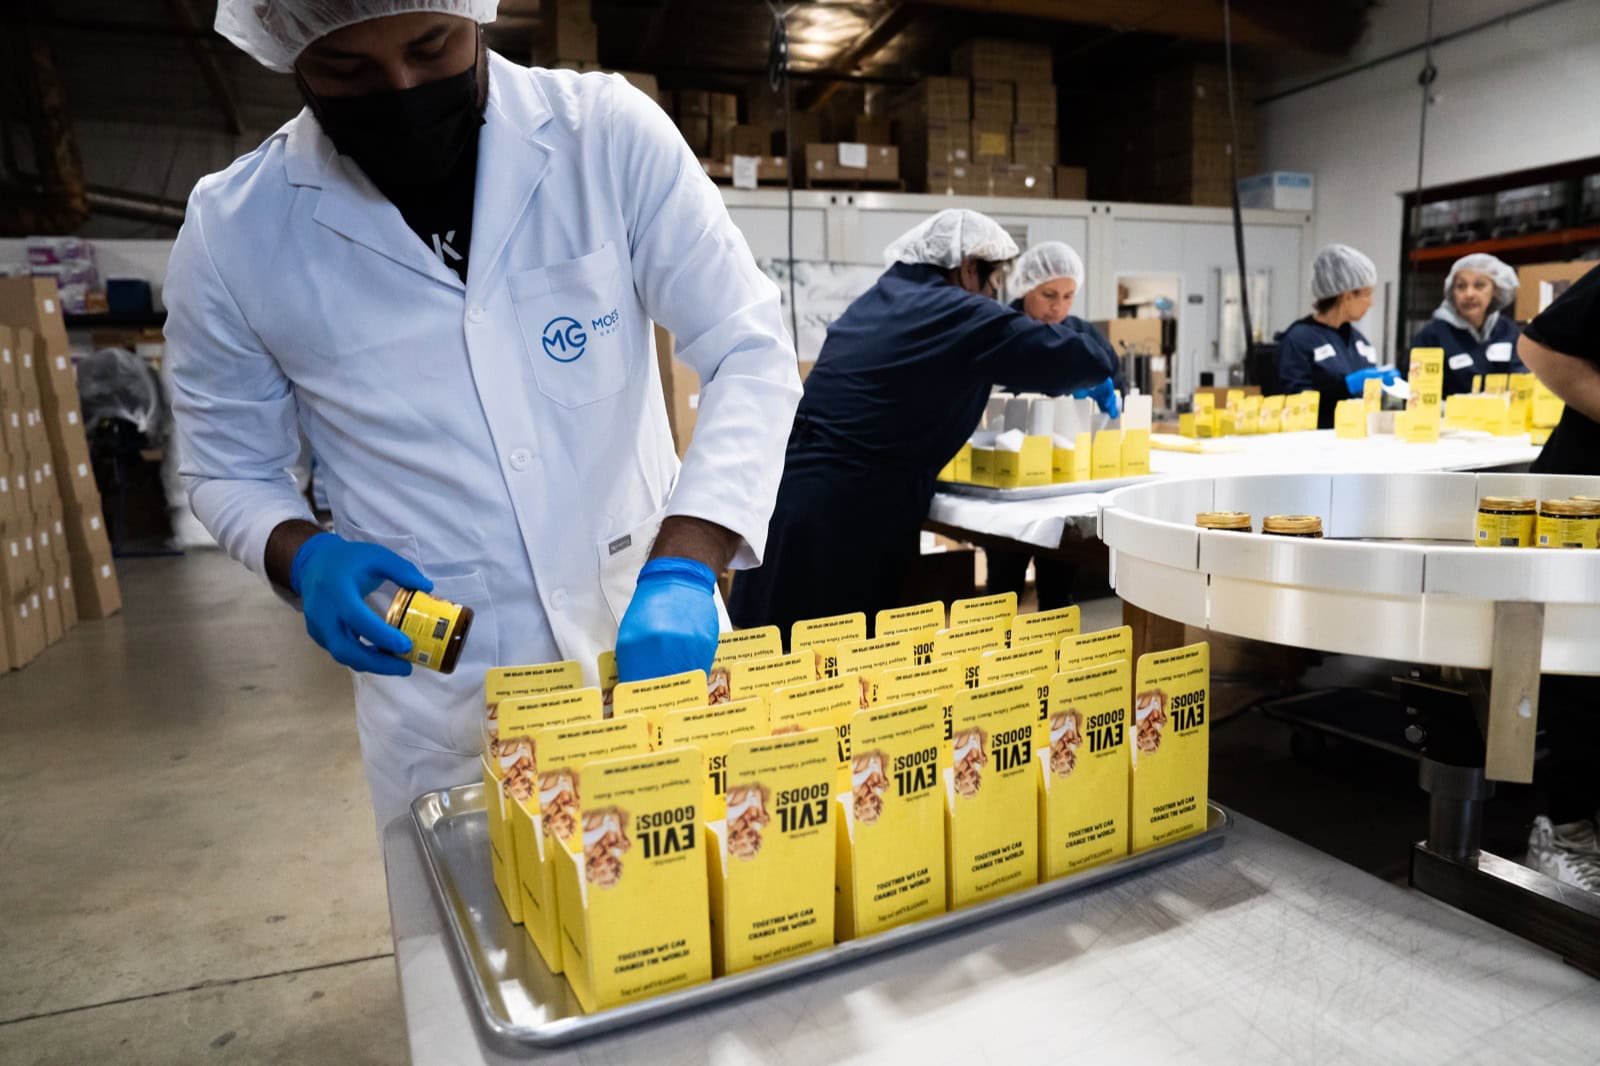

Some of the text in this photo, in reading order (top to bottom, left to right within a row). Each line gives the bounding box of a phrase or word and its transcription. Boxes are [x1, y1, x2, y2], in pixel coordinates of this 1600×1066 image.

[542, 321, 587, 354] MG
[1171, 689, 1205, 709] GOODS!
[1086, 708, 1124, 730] GOODS!
[1171, 704, 1204, 732] EVIL
[992, 726, 1032, 749] GOODS!
[1086, 723, 1123, 752] EVIL
[894, 747, 937, 771] GOODS!
[992, 742, 1031, 772] EVIL
[894, 763, 937, 796] EVIL
[776, 783, 829, 806] GOODS!
[637, 805, 695, 830] GOODS!
[776, 800, 828, 833] EVIL
[637, 823, 695, 859] EVIL
